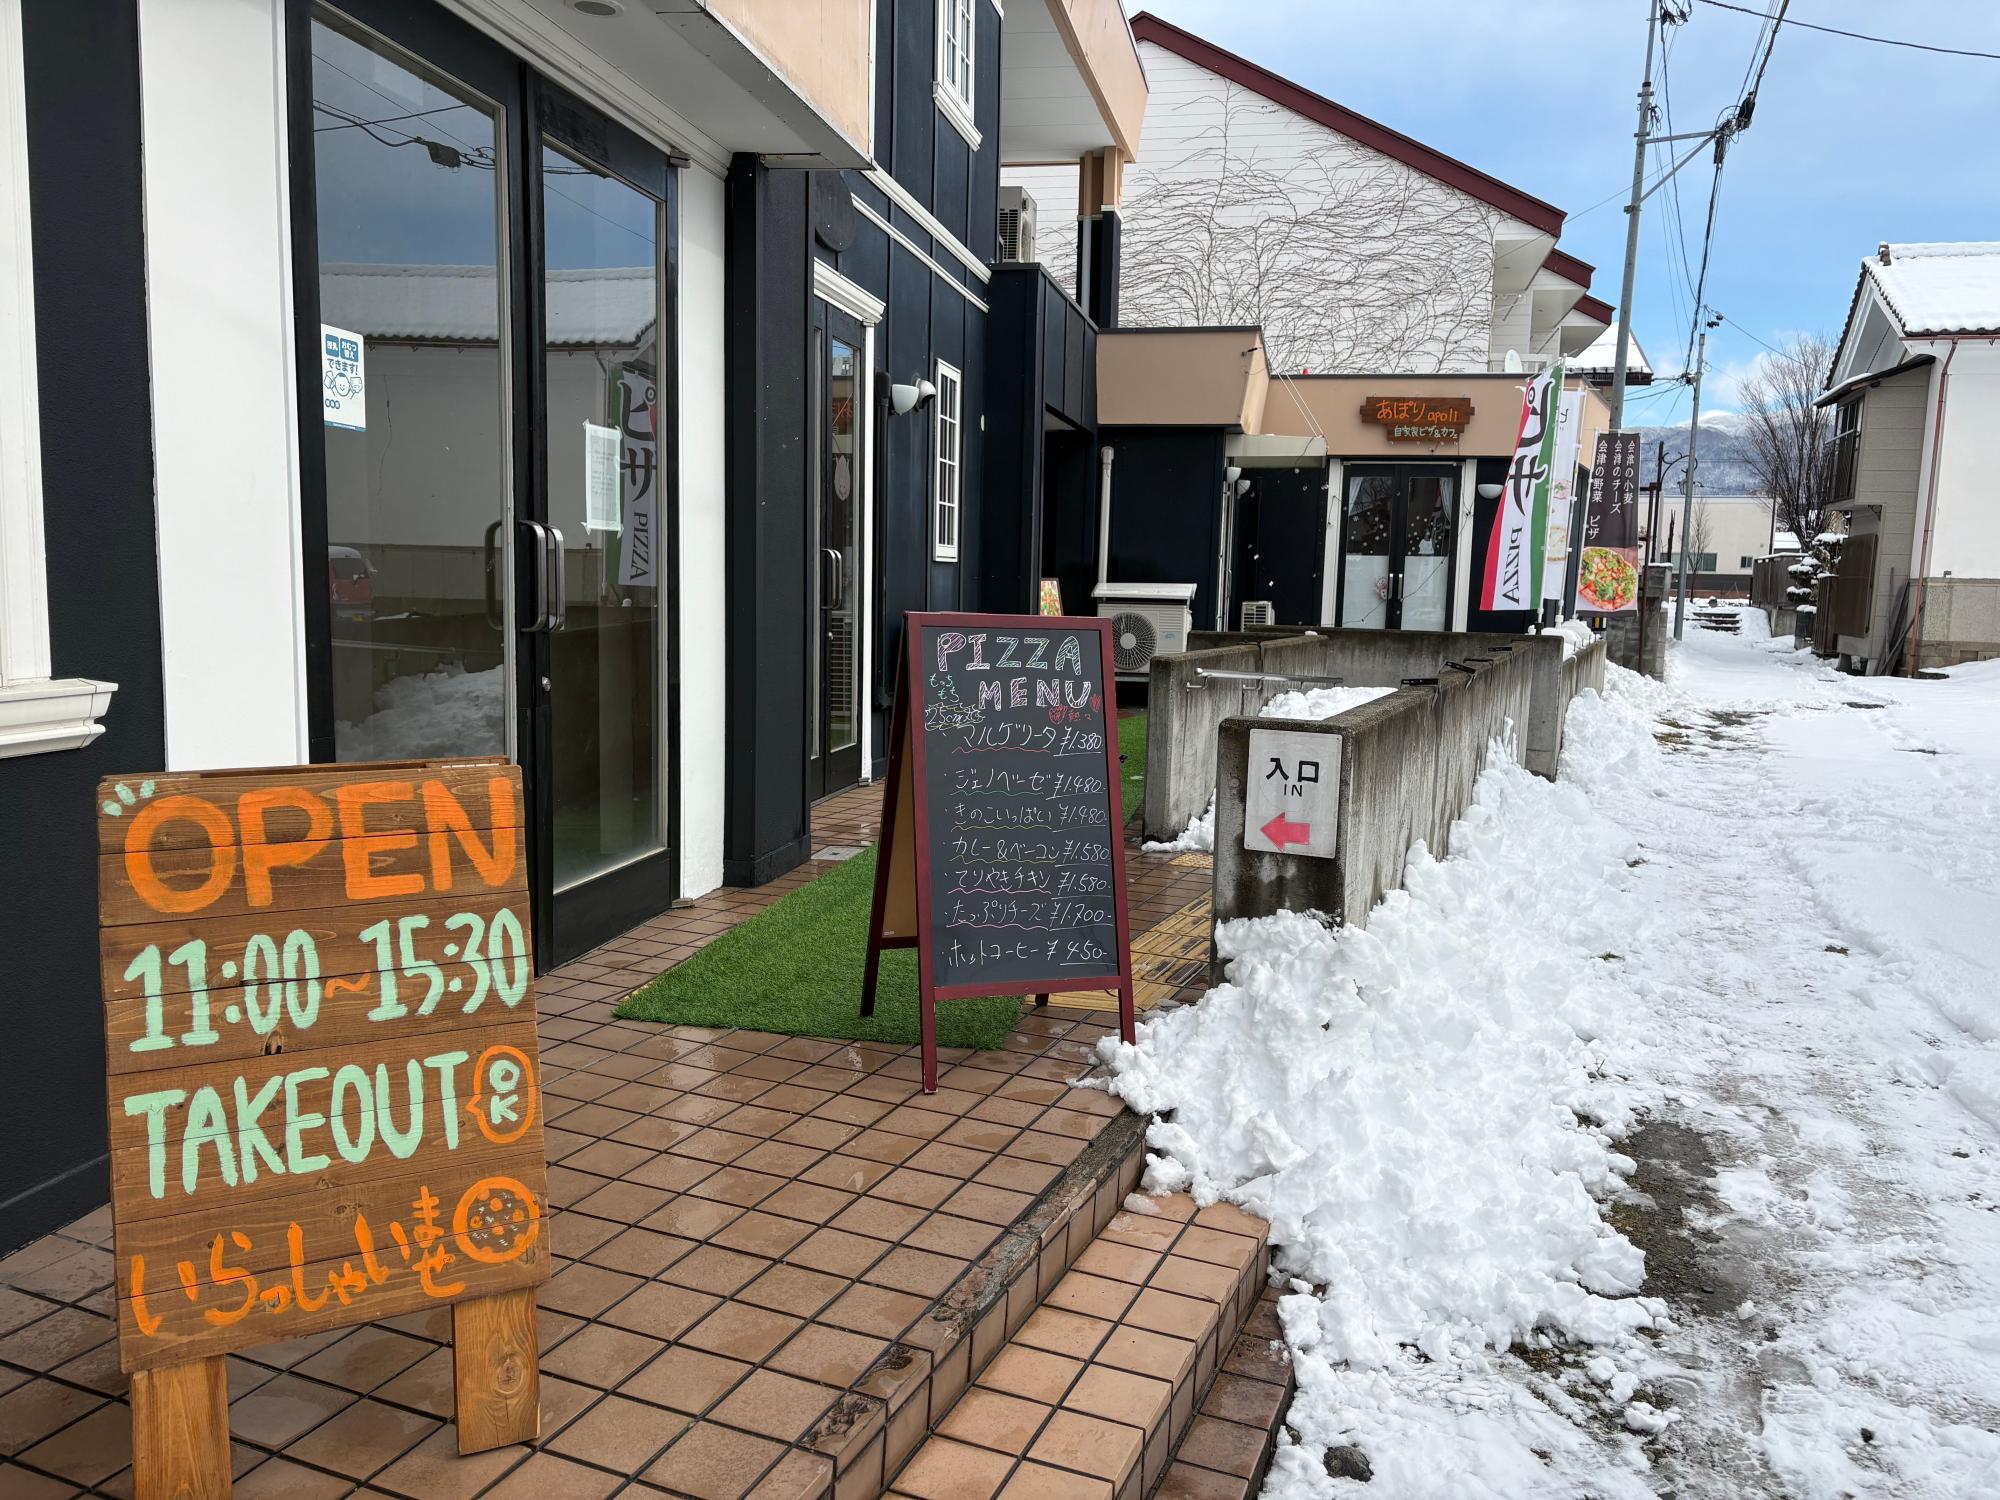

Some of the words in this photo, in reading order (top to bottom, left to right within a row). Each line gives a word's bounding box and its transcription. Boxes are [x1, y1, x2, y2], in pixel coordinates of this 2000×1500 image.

[1376, 400, 1426, 421] あぽり
[1427, 408, 1458, 424] apoli
[1592, 440, 1608, 503] 会津の野菜
[1610, 440, 1623, 514] 会津のチーズ
[1623, 440, 1636, 504] 会津の小麦
[1587, 515, 1600, 540] ピザ
[630, 512, 649, 581] PIZZA
[937, 632, 1082, 676] PIZZA
[978, 677, 1092, 711] MENU
[958, 722, 1056, 748] マルゲリータ
[955, 768, 1051, 790] ジェノベーゼ
[1266, 758, 1320, 783] 入口
[1284, 784, 1302, 797] IN
[125, 776, 518, 913] OPEN
[955, 866, 1051, 890] てりやきチキン
[952, 899, 1047, 924] たっぷりチーズ
[948, 939, 1039, 967] ホットコーヒー
[124, 1050, 469, 1199] TAKEOUT
[490, 1060, 519, 1124] OK
